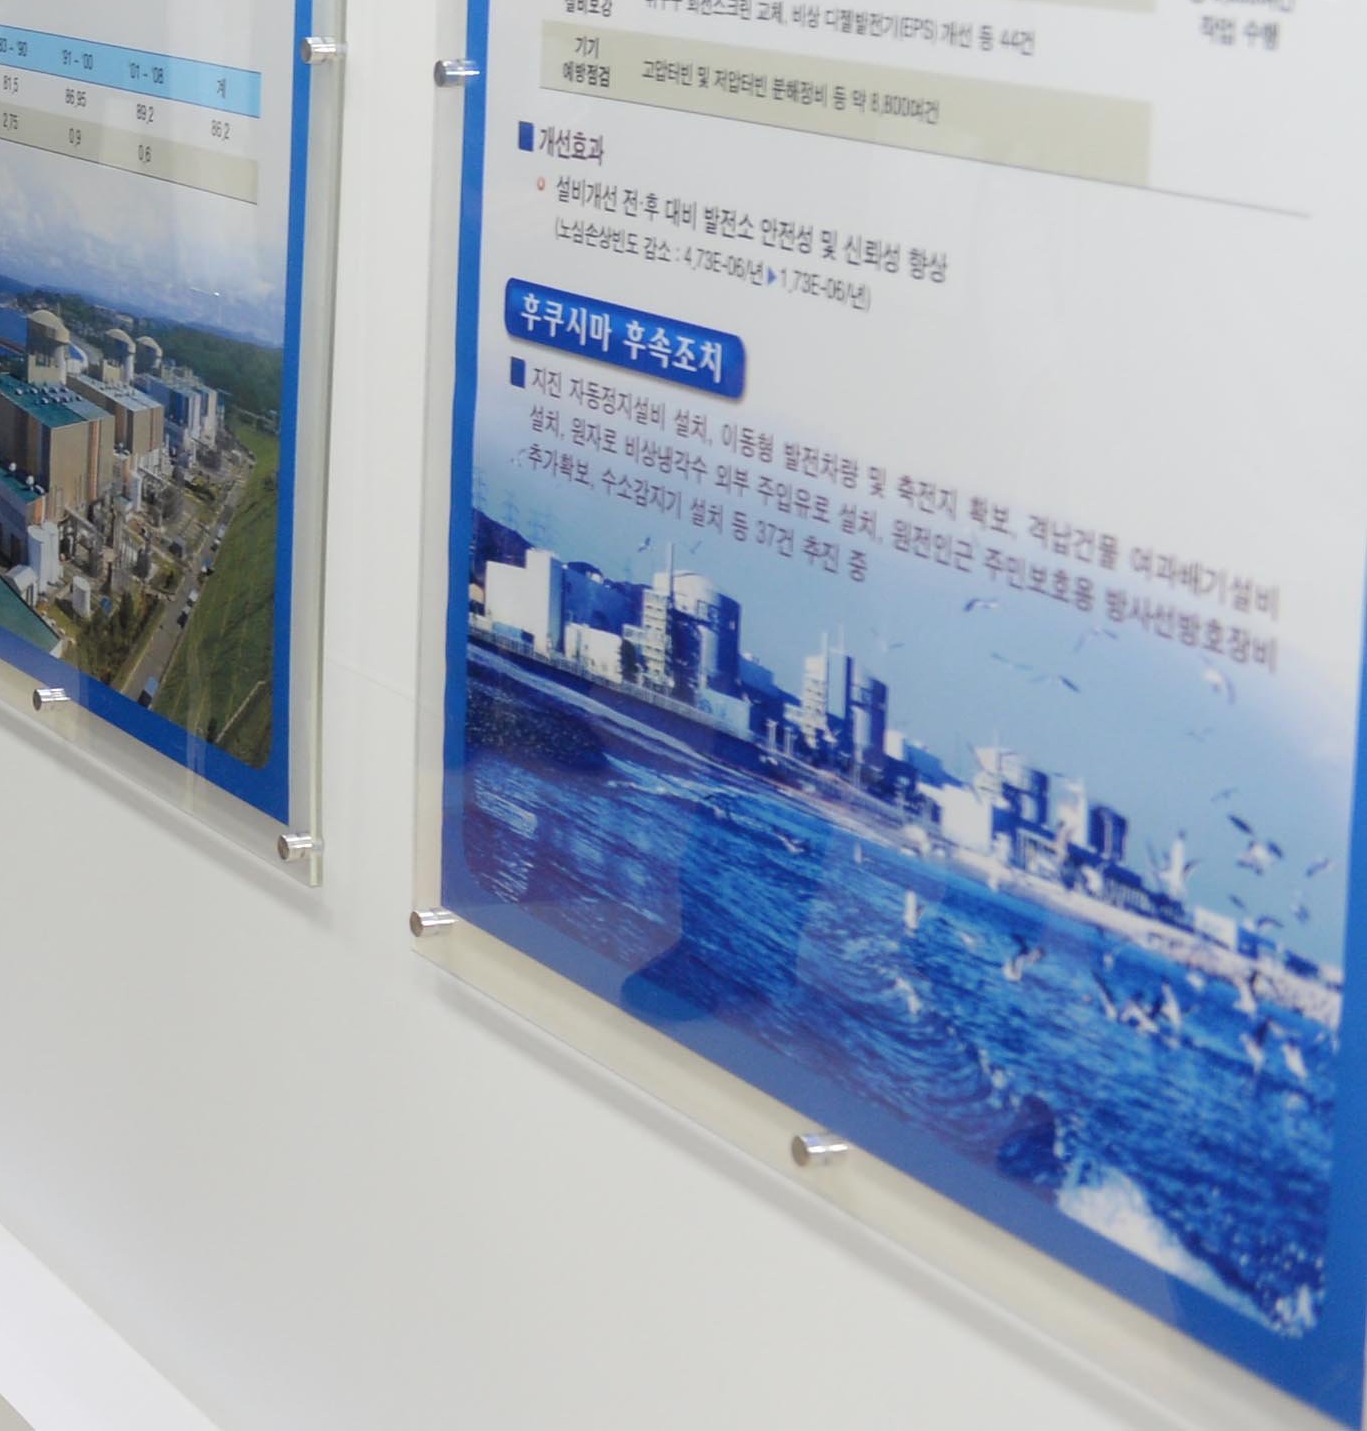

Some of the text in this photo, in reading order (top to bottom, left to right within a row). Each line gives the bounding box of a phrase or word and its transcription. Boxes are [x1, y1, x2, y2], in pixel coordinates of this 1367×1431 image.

[574, 35, 601, 60] 기기
[539, 125, 605, 167] 개선효과
[556, 174, 949, 284] 설비개선 대비 발전소 안전성 및 신뢰성 향상
[644, 235, 672, 263] 감소
[520, 293, 723, 384] 후쿠시마 후속조치
[532, 368, 563, 400] 지진
[569, 377, 666, 432] 자동정지설비
[721, 422, 775, 464] 이동형
[783, 441, 860, 490] 발전차량
[868, 465, 888, 500] 및
[897, 474, 958, 522] 축전지
[570, 416, 619, 455] 원자로
[624, 434, 709, 485] 비상냉각수
[714, 464, 750, 498] 외부
[755, 474, 832, 525] 주입유로
[891, 518, 975, 573] 원전인근
[600, 468, 683, 521] 수소감지기
[689, 497, 725, 535] 설치
[731, 509, 750, 543] 등
[801, 533, 841, 576] 추진
[848, 548, 869, 583] 중
